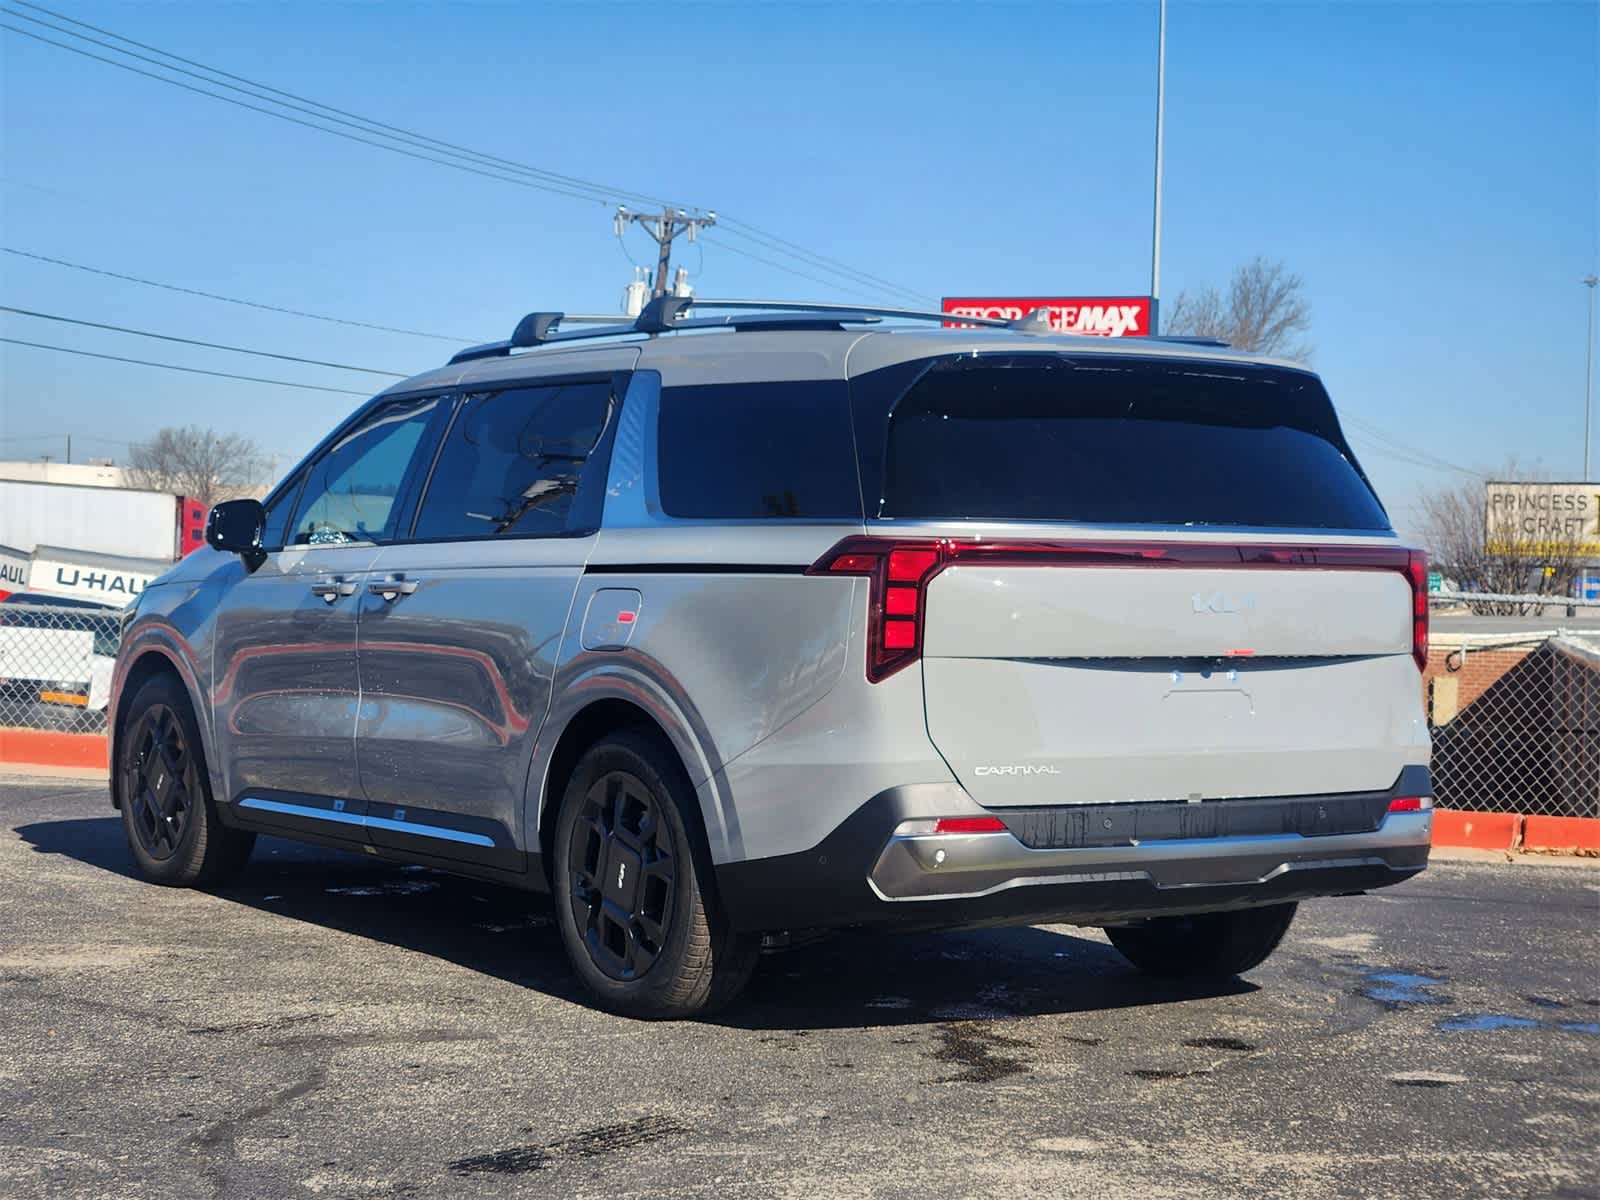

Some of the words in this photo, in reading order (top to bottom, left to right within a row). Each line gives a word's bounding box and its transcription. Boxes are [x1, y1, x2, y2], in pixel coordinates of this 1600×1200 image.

[951, 306, 1141, 334] STORGEMAX
[1493, 493, 1588, 511] PRINCESS
[1523, 518, 1584, 535] CRAFT
